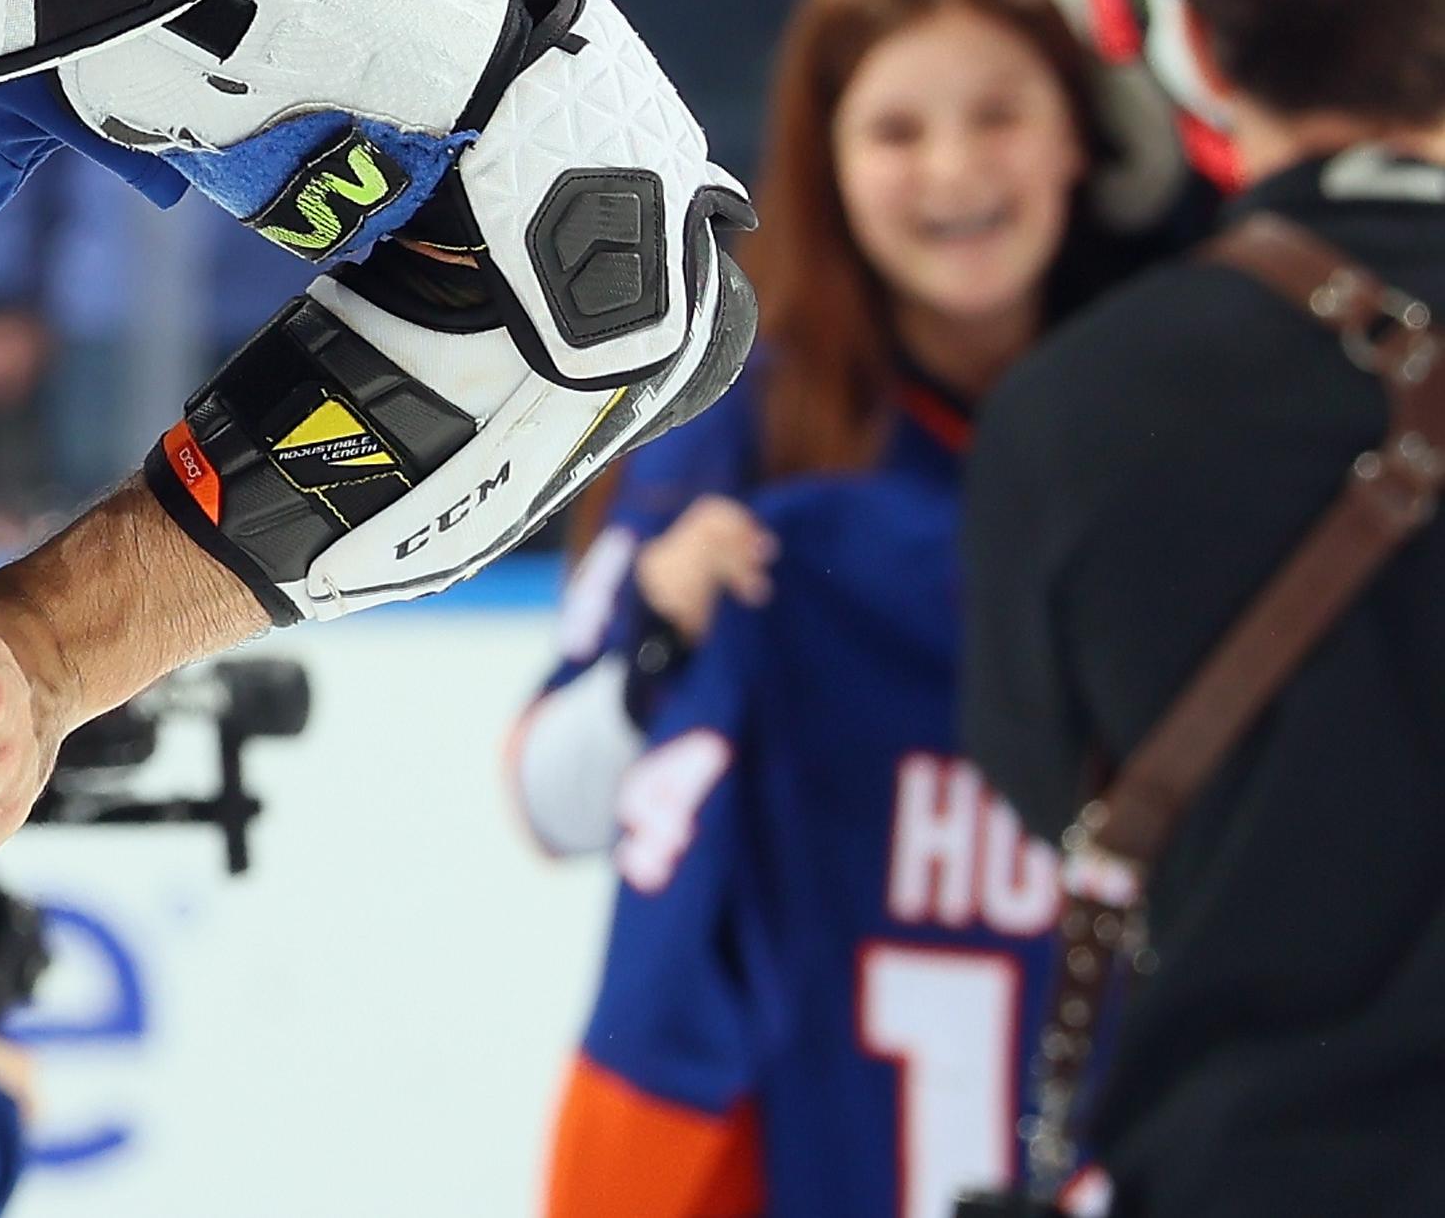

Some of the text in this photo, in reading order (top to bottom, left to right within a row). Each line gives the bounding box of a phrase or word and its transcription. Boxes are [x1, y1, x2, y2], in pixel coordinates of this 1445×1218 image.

[278, 435, 372, 461] ADJUSTABLE
[322, 444, 378, 461] LENGTH
[394, 460, 510, 560] CCM
